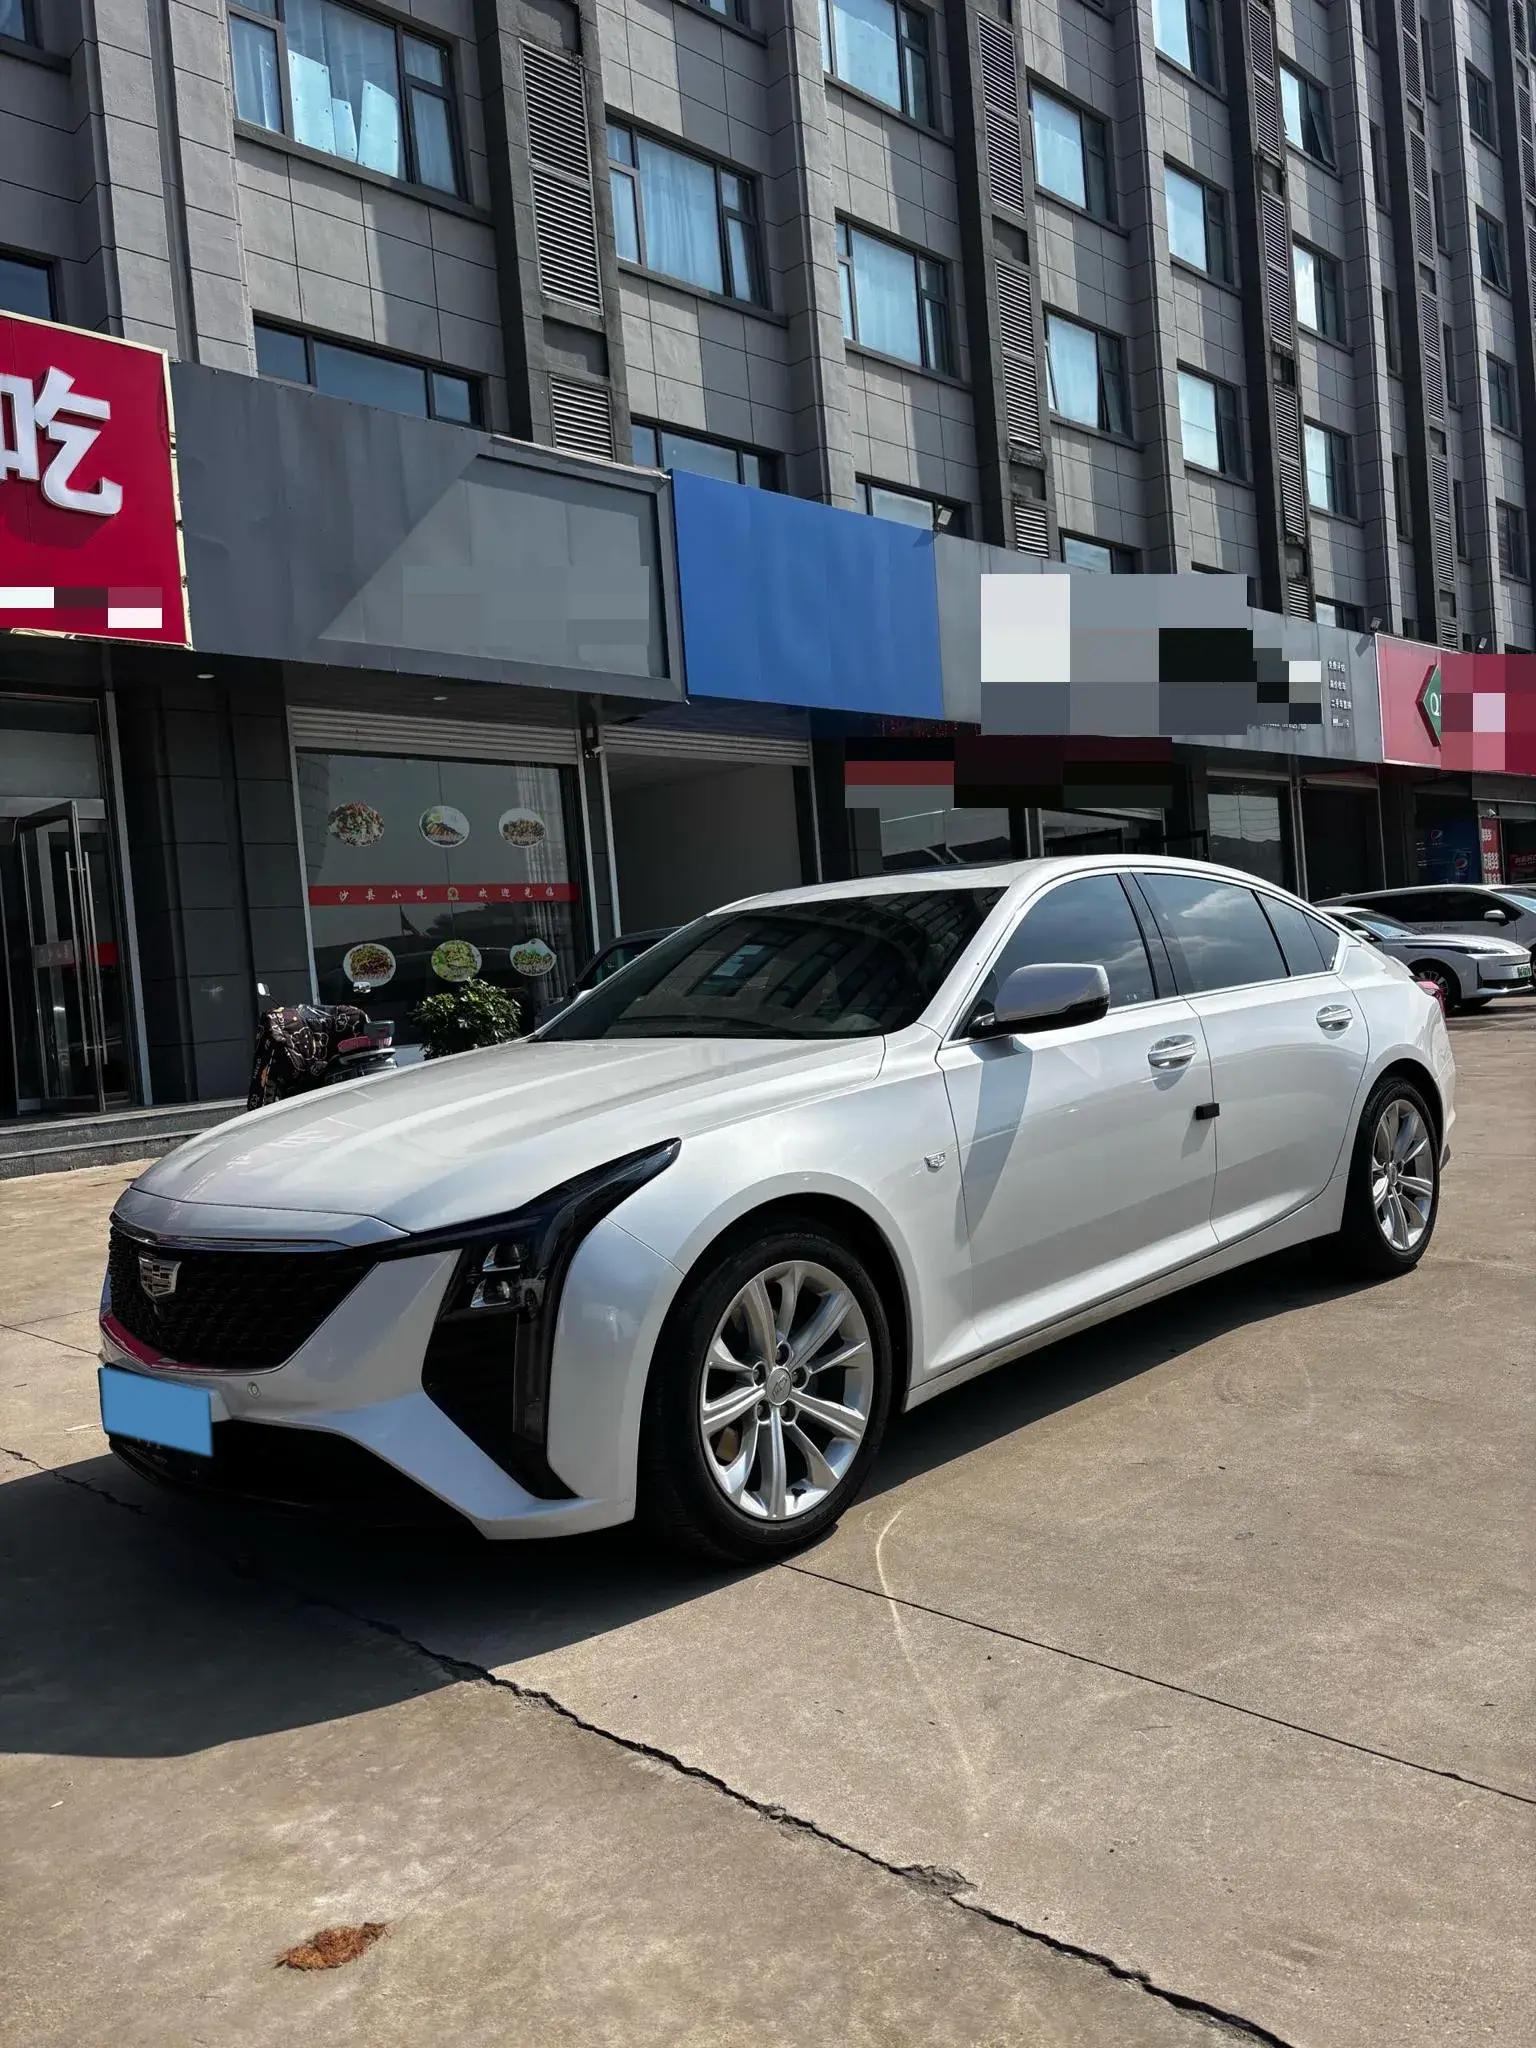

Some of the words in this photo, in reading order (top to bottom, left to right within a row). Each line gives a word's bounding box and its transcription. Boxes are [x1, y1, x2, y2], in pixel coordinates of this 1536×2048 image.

[0, 366, 123, 517] 吃
[338, 888, 428, 902] 沙县小吃
[478, 887, 555, 898] 欢迎光临
